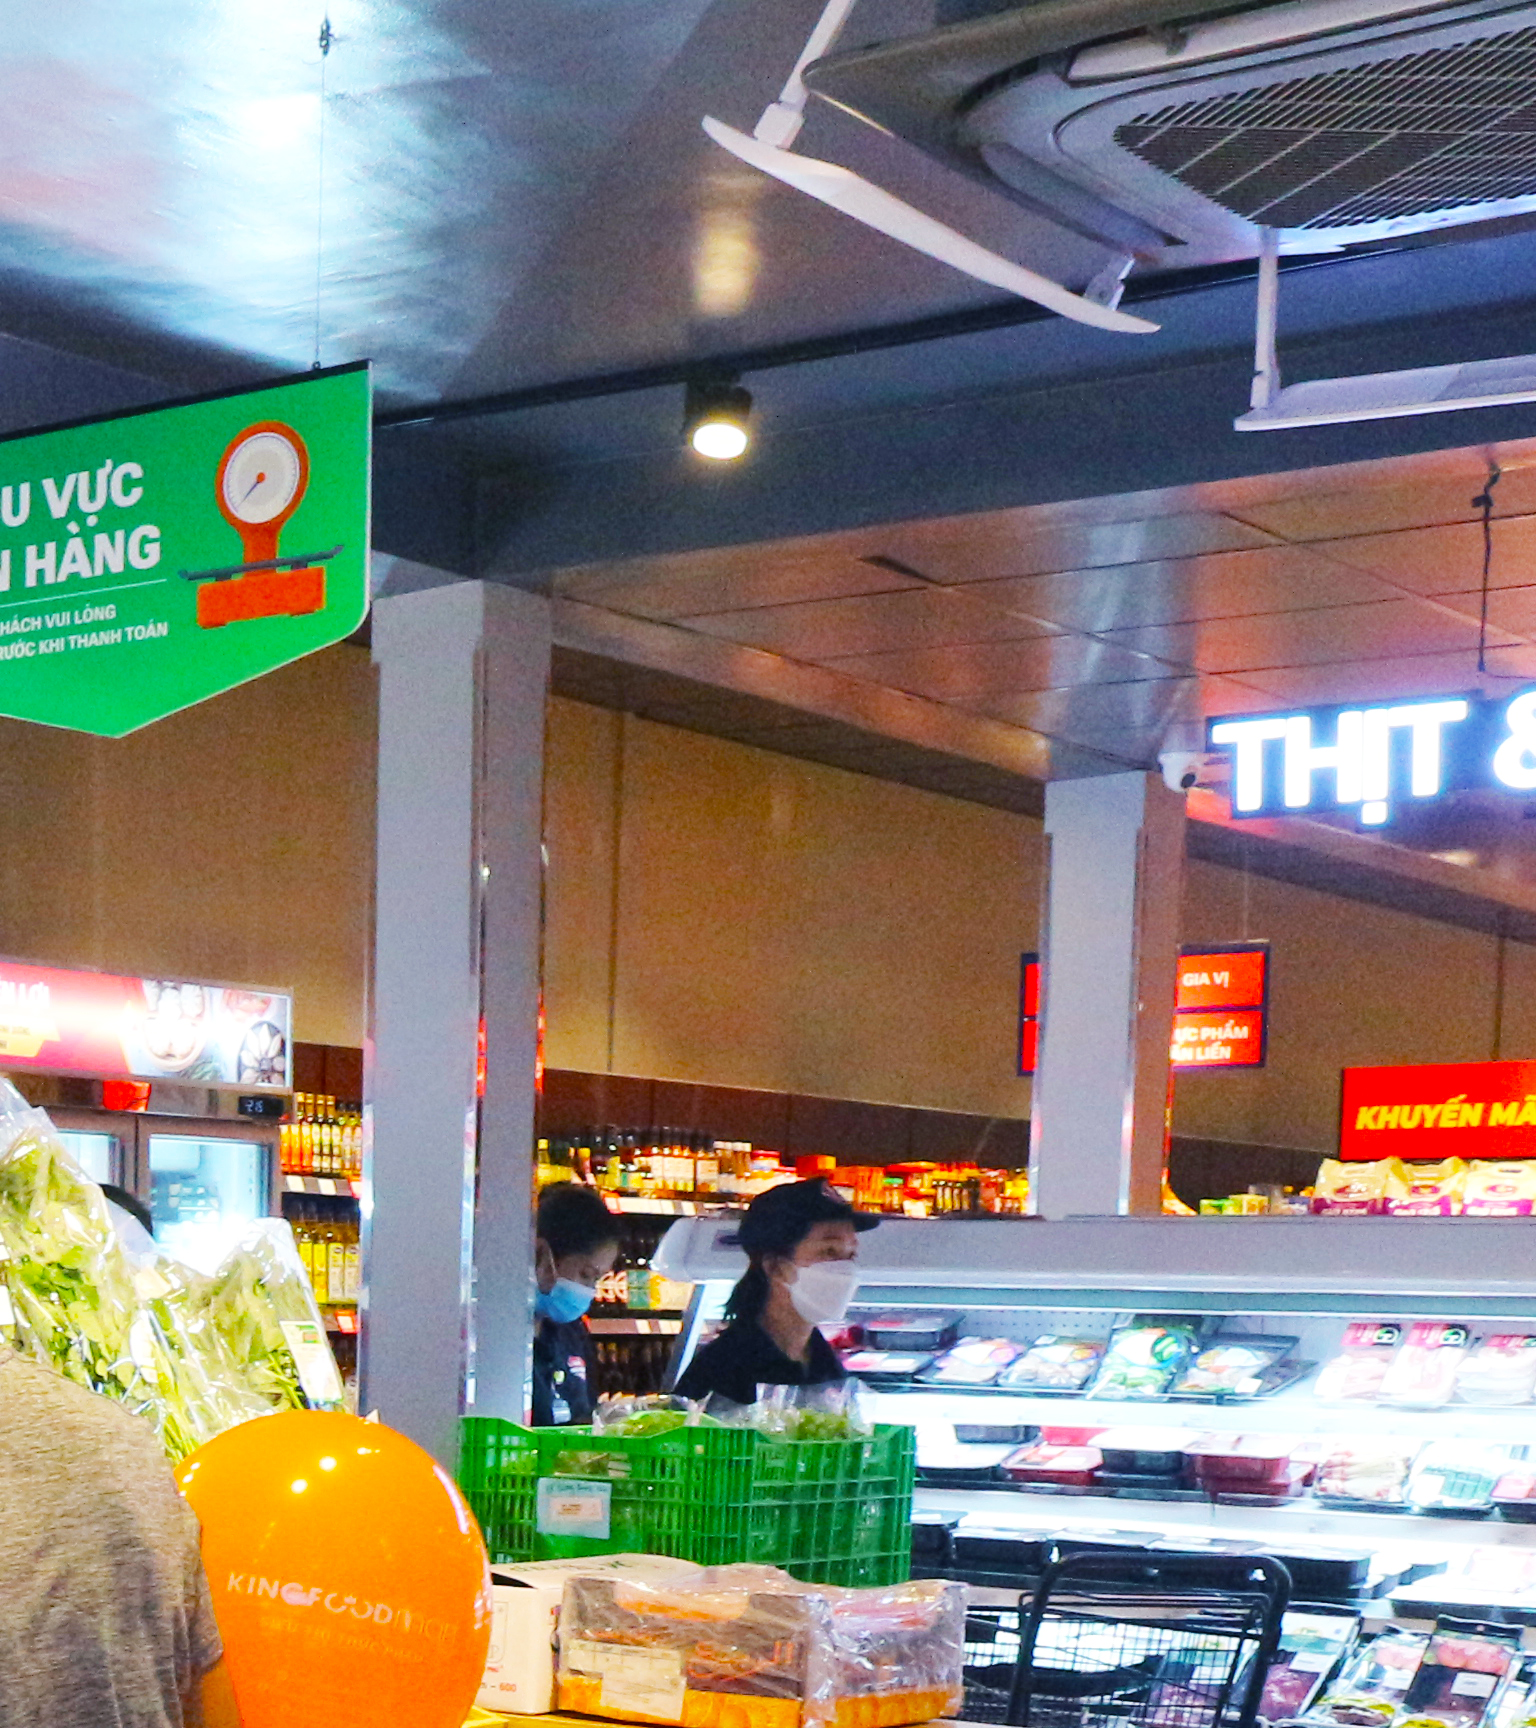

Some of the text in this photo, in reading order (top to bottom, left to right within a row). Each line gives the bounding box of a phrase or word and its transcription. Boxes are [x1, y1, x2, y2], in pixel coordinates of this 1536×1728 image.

[41, 459, 144, 528] VỰC
[24, 520, 162, 588] HÀNG
[38, 636, 65, 655] KHI
[68, 629, 122, 650] THANH
[125, 618, 170, 642] TOÁN
[44, 609, 71, 629] VUI
[1211, 699, 1469, 826] THỊT
[1182, 970, 1230, 989] GIA VỊ
[1354, 1093, 1536, 1131] KHUYẾN MÃ
